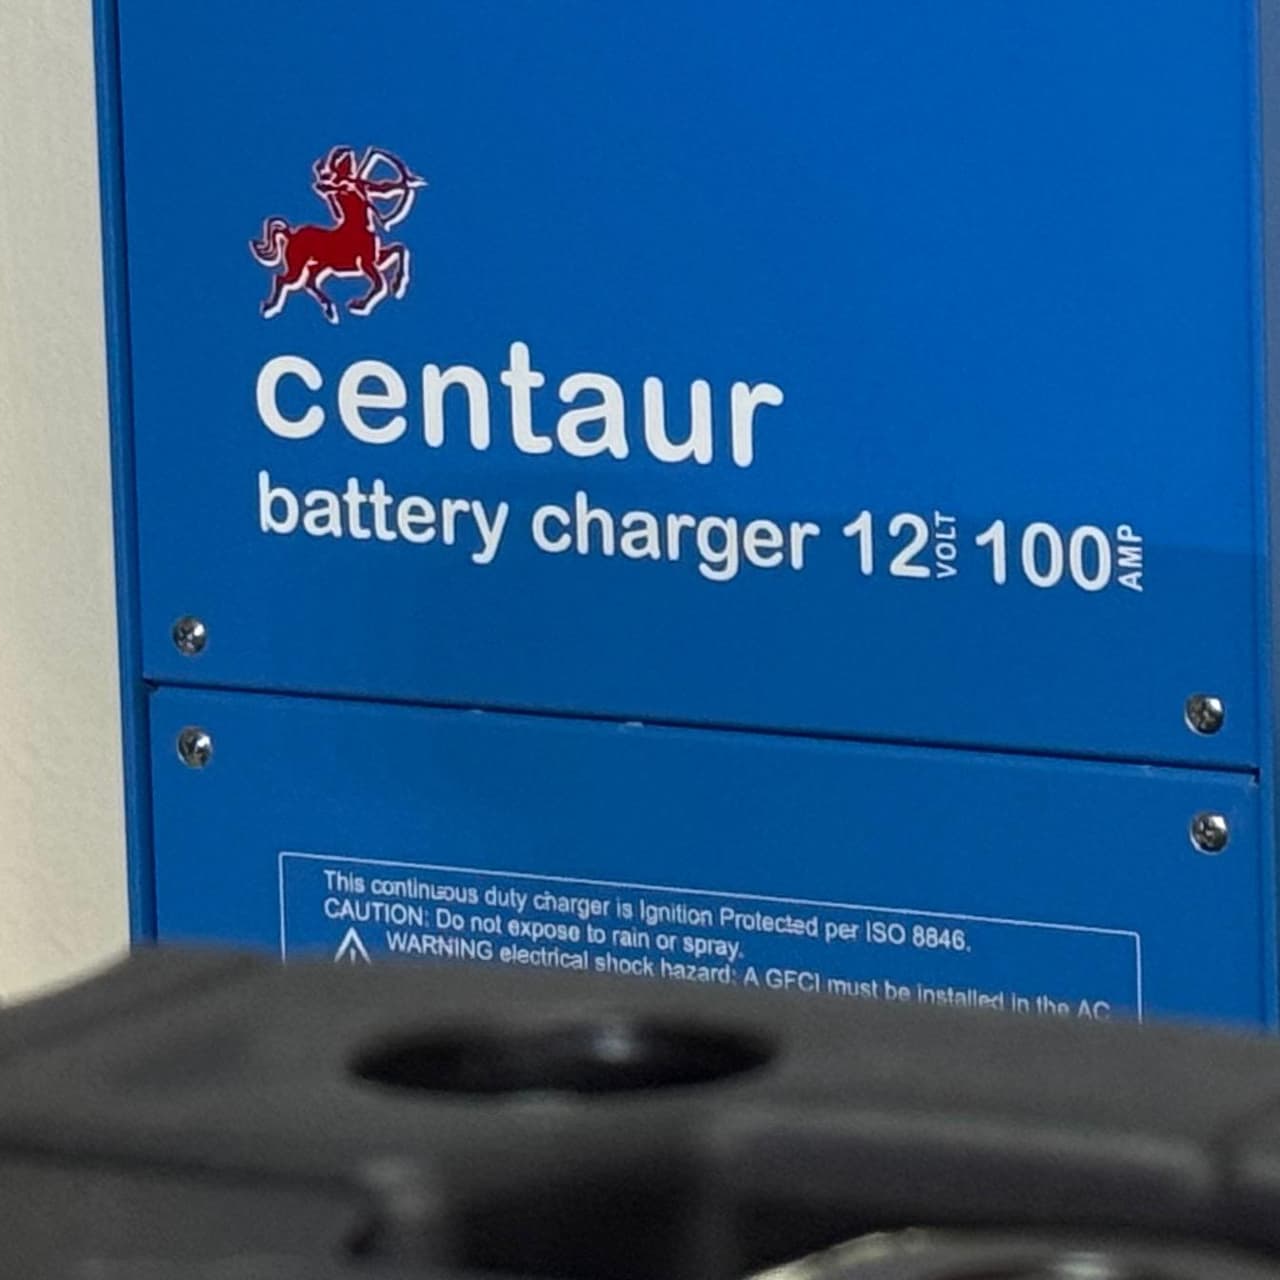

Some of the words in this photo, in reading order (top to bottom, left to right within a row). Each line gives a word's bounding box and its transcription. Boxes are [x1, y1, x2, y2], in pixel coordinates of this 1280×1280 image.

[256, 341, 784, 468] centaur
[258, 470, 510, 565] battery
[531, 491, 820, 582] charger
[842, 509, 931, 579] 12
[934, 510, 958, 579] VOLT
[975, 519, 1112, 592] 100
[1117, 523, 1143, 593] AMP
[323, 869, 366, 894] This
[371, 878, 479, 905] continuous
[484, 885, 527, 913] duty
[533, 890, 611, 920] charger
[616, 896, 633, 920] is
[639, 898, 713, 926] Ignition
[720, 907, 819, 938] Protected
[824, 920, 860, 943] per
[865, 919, 906, 945] ISO
[911, 925, 971, 952] 8846.
[323, 897, 428, 926] CAUTION:
[436, 908, 465, 932] Do
[470, 915, 503, 935] not
[507, 917, 581, 944] expose
[586, 923, 607, 944] to
[612, 927, 650, 950] rain
[655, 933, 676, 951] or
[682, 933, 744, 963] spray.
[386, 930, 494, 961] WARNING
[499, 946, 589, 971] electrical
[594, 955, 655, 978] shock
[661, 957, 737, 986] hazard:
[744, 966, 760, 988] A
[765, 968, 821, 993] GFCI
[827, 978, 879, 1000] must
[884, 980, 911, 1002] be
[917, 983, 1004, 1012] installed
[1011, 992, 1030, 1014] in
[1036, 995, 1070, 1017] the
[1077, 999, 1111, 1021] AC
